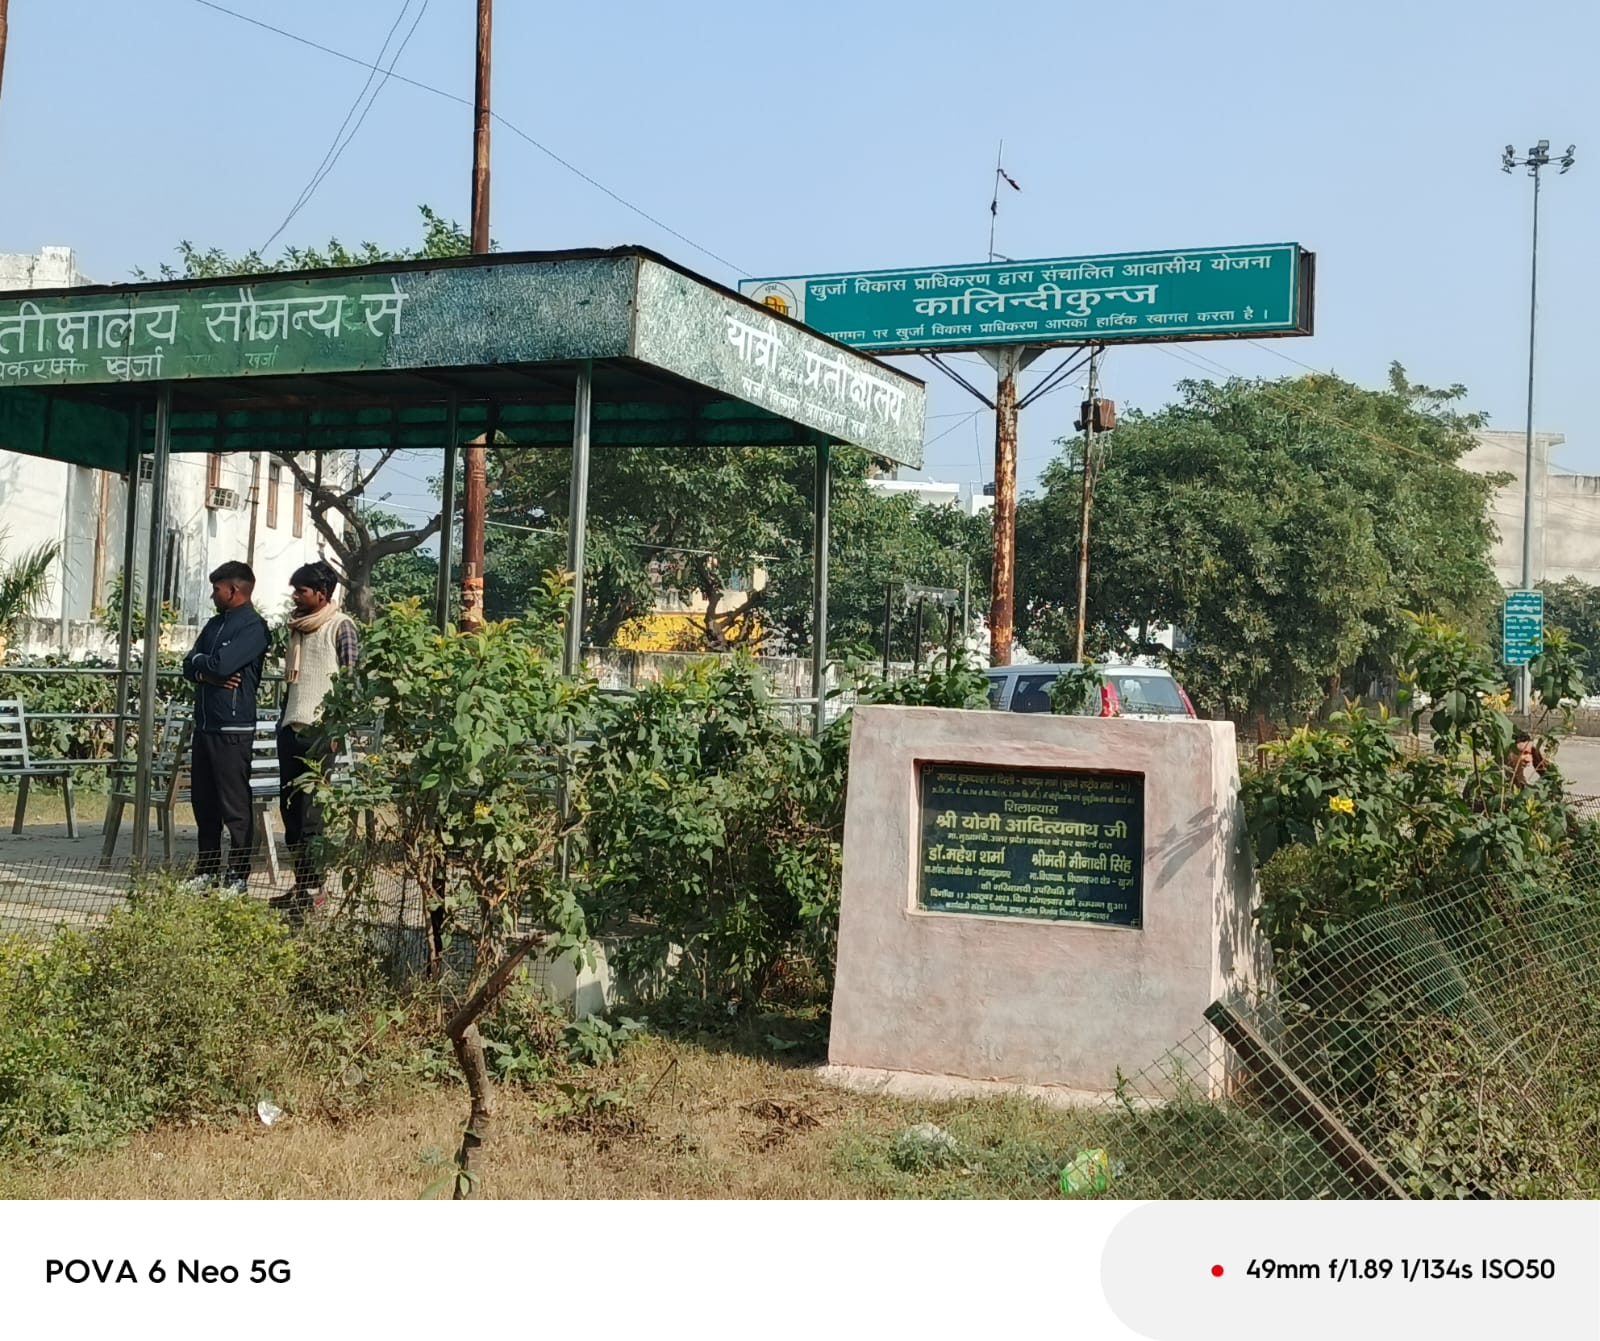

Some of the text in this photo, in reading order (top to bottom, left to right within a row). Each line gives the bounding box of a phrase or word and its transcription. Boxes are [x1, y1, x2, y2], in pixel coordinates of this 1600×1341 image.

[809, 253, 1272, 301] खुर्जा विकास प्राधिकरण द्वारा संचालित आवासीय योजना
[361, 278, 410, 337] से
[913, 283, 1160, 317] कालिन्दीकुन्ज
[872, 328, 889, 340] पर
[895, 324, 925, 342] खुर्जा
[931, 322, 973, 337] विकास
[979, 318, 1038, 336] प्राधिकरण
[1045, 317, 1088, 329] आपका
[1096, 312, 1138, 328] हार्दिक
[1197, 309, 1236, 322] करता
[1243, 304, 1255, 321] है
[725, 314, 907, 427] यात्री प्रतीक्षालय
[1004, 799, 1060, 815] शिलान्यास
[935, 810, 1128, 839] श्री योगी आदित्यनाथ जी
[979, 846, 1006, 864] शर्मा
[1032, 848, 1134, 874] श्रीमती मीनाक्षी सिंह
